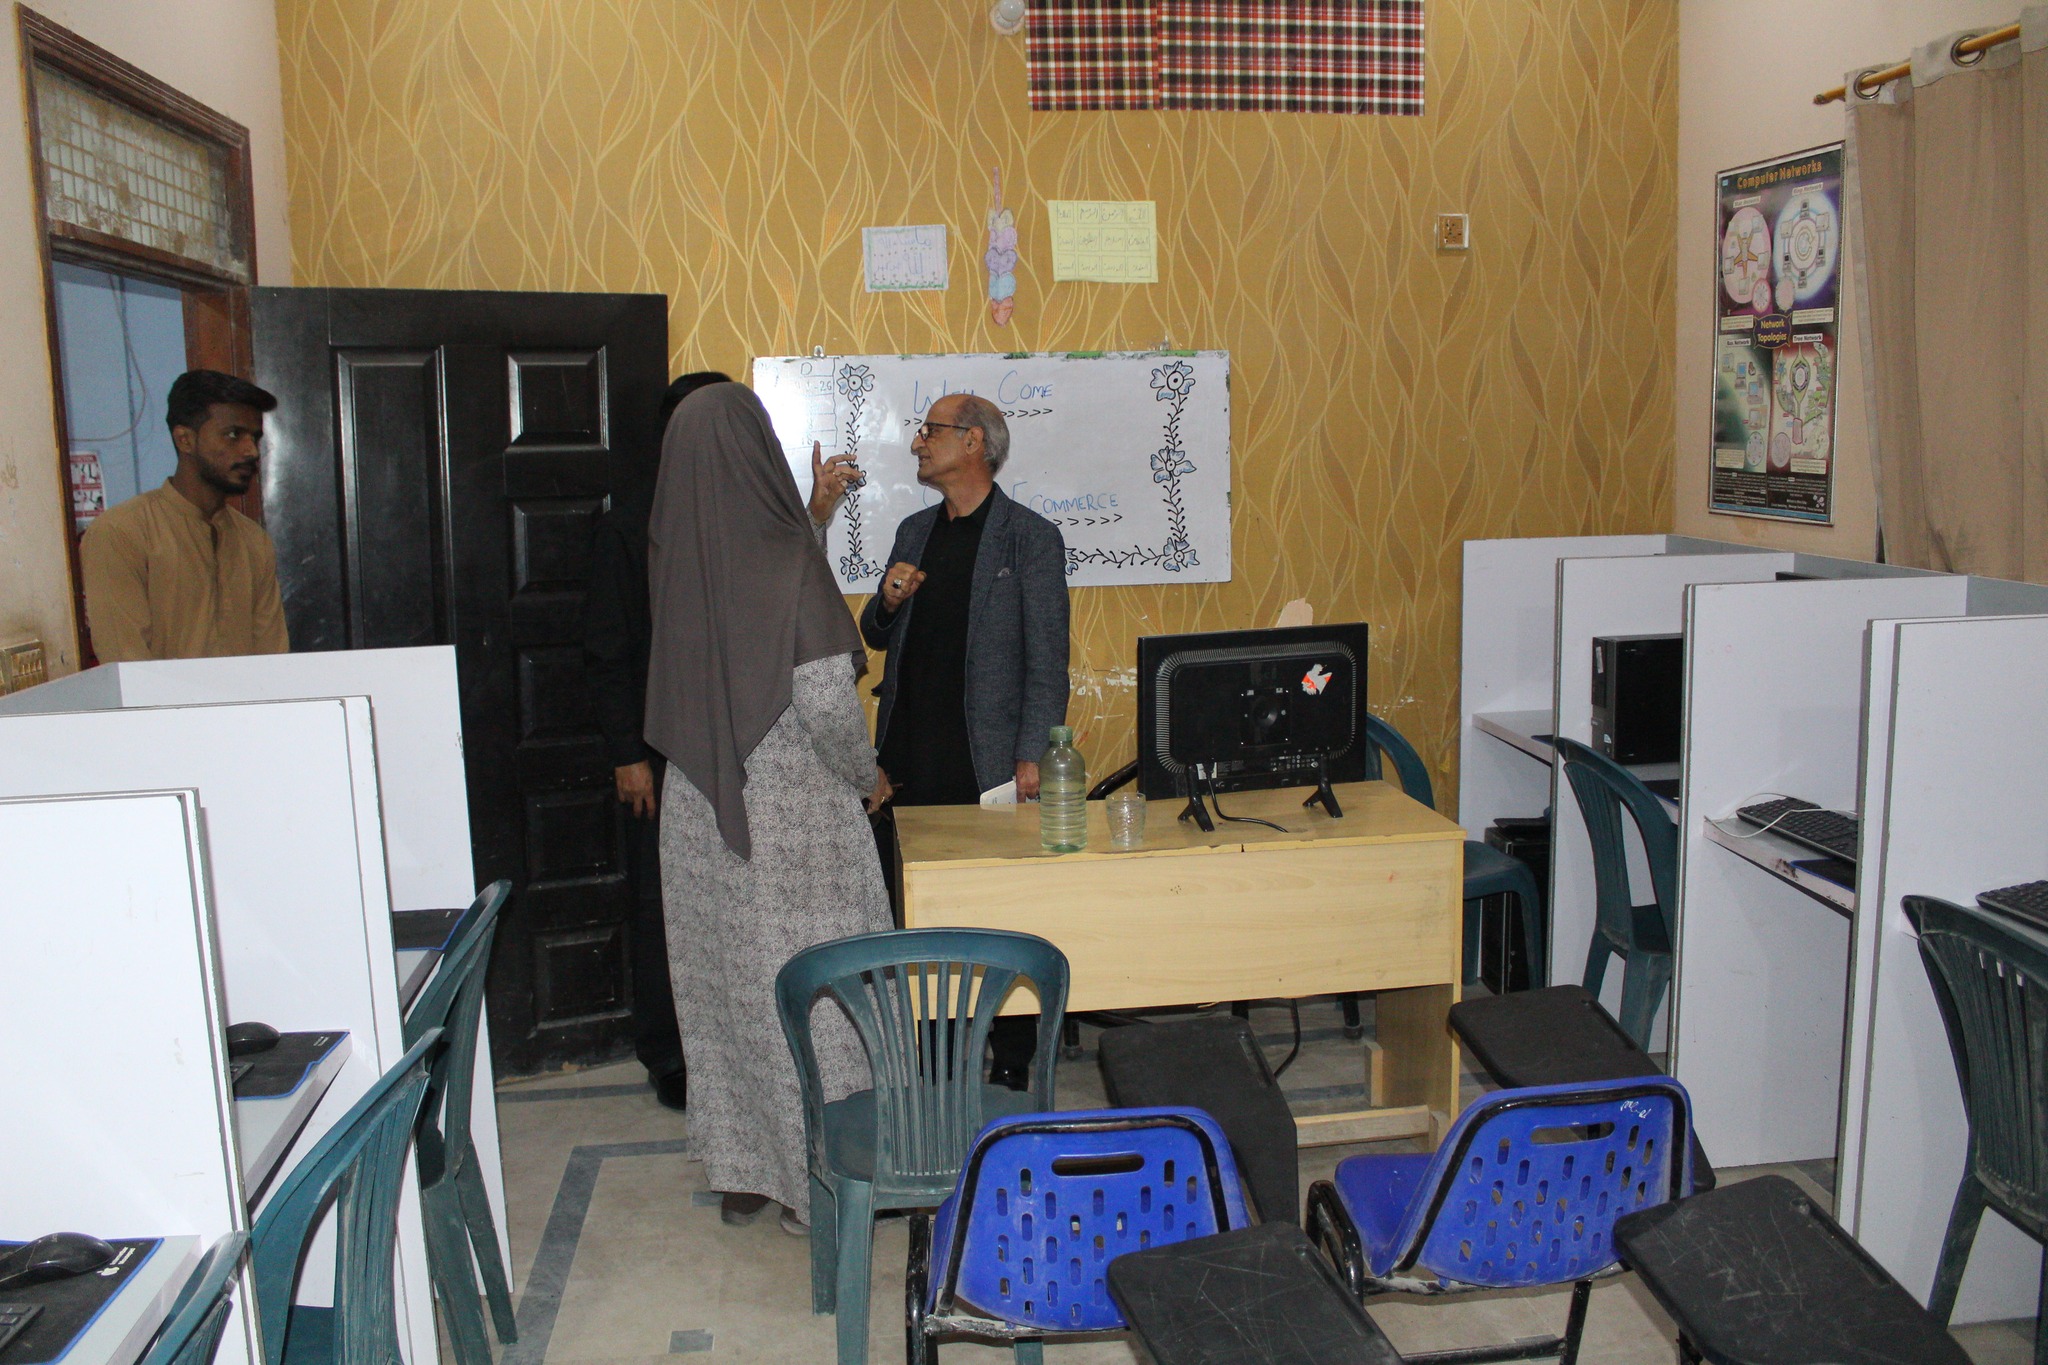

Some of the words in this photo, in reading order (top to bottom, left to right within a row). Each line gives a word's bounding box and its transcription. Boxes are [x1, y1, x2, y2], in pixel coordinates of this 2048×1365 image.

[1737, 172, 1778, 190] Computer
[1779, 160, 1823, 182] Networks
[1760, 319, 1786, 330] Network
[1757, 332, 1788, 344] Topologies
[1804, 334, 1822, 342] Network
[1029, 493, 1119, 516] COMMERCE
